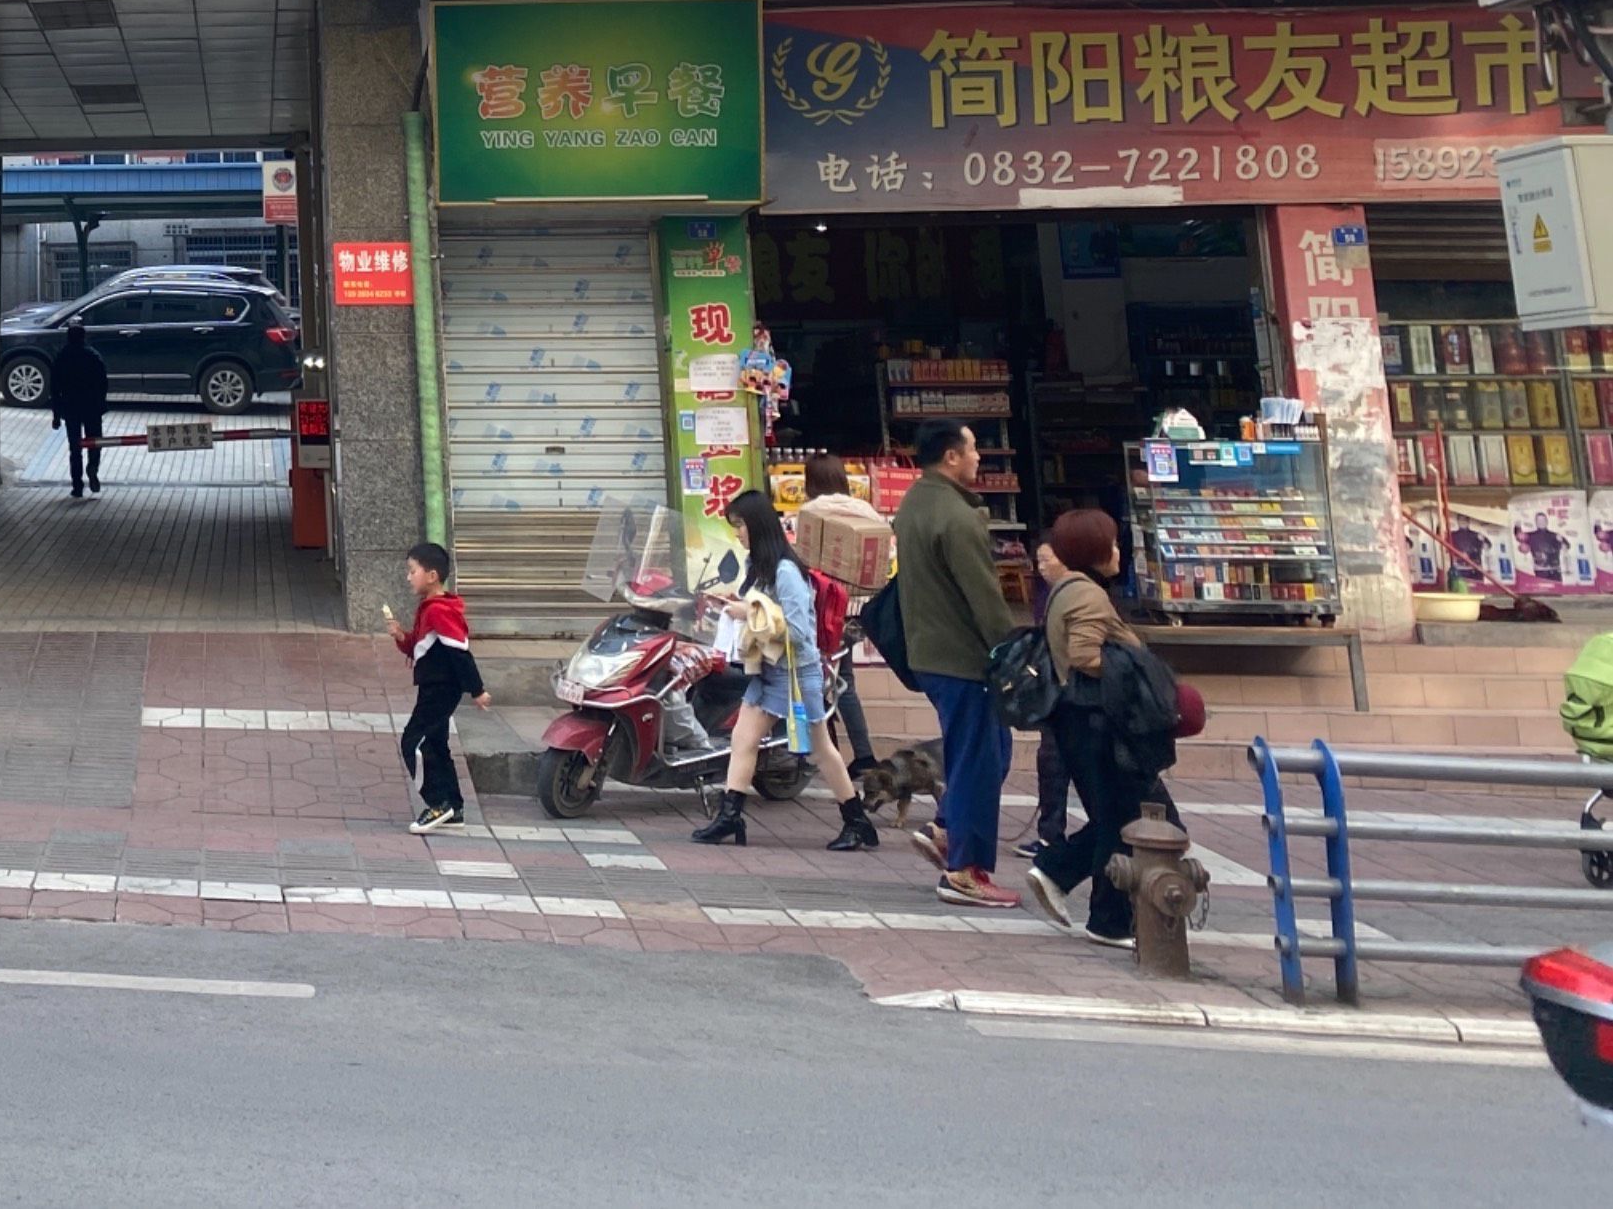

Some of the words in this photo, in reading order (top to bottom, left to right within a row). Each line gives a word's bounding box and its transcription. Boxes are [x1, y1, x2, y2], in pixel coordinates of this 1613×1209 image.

[920, 13, 1560, 129] 简阳粮友超市
[474, 62, 725, 120] 营养早餐
[480, 131, 534, 148] YING
[544, 130, 605, 148] YANG
[614, 129, 660, 147] ZAO
[669, 128, 717, 147] CAN
[963, 144, 1320, 187] 0832-7221808
[339, 250, 409, 273] 物业维修
[152, 424, 208, 437] 本停车场
[152, 435, 209, 449] 客户优先
